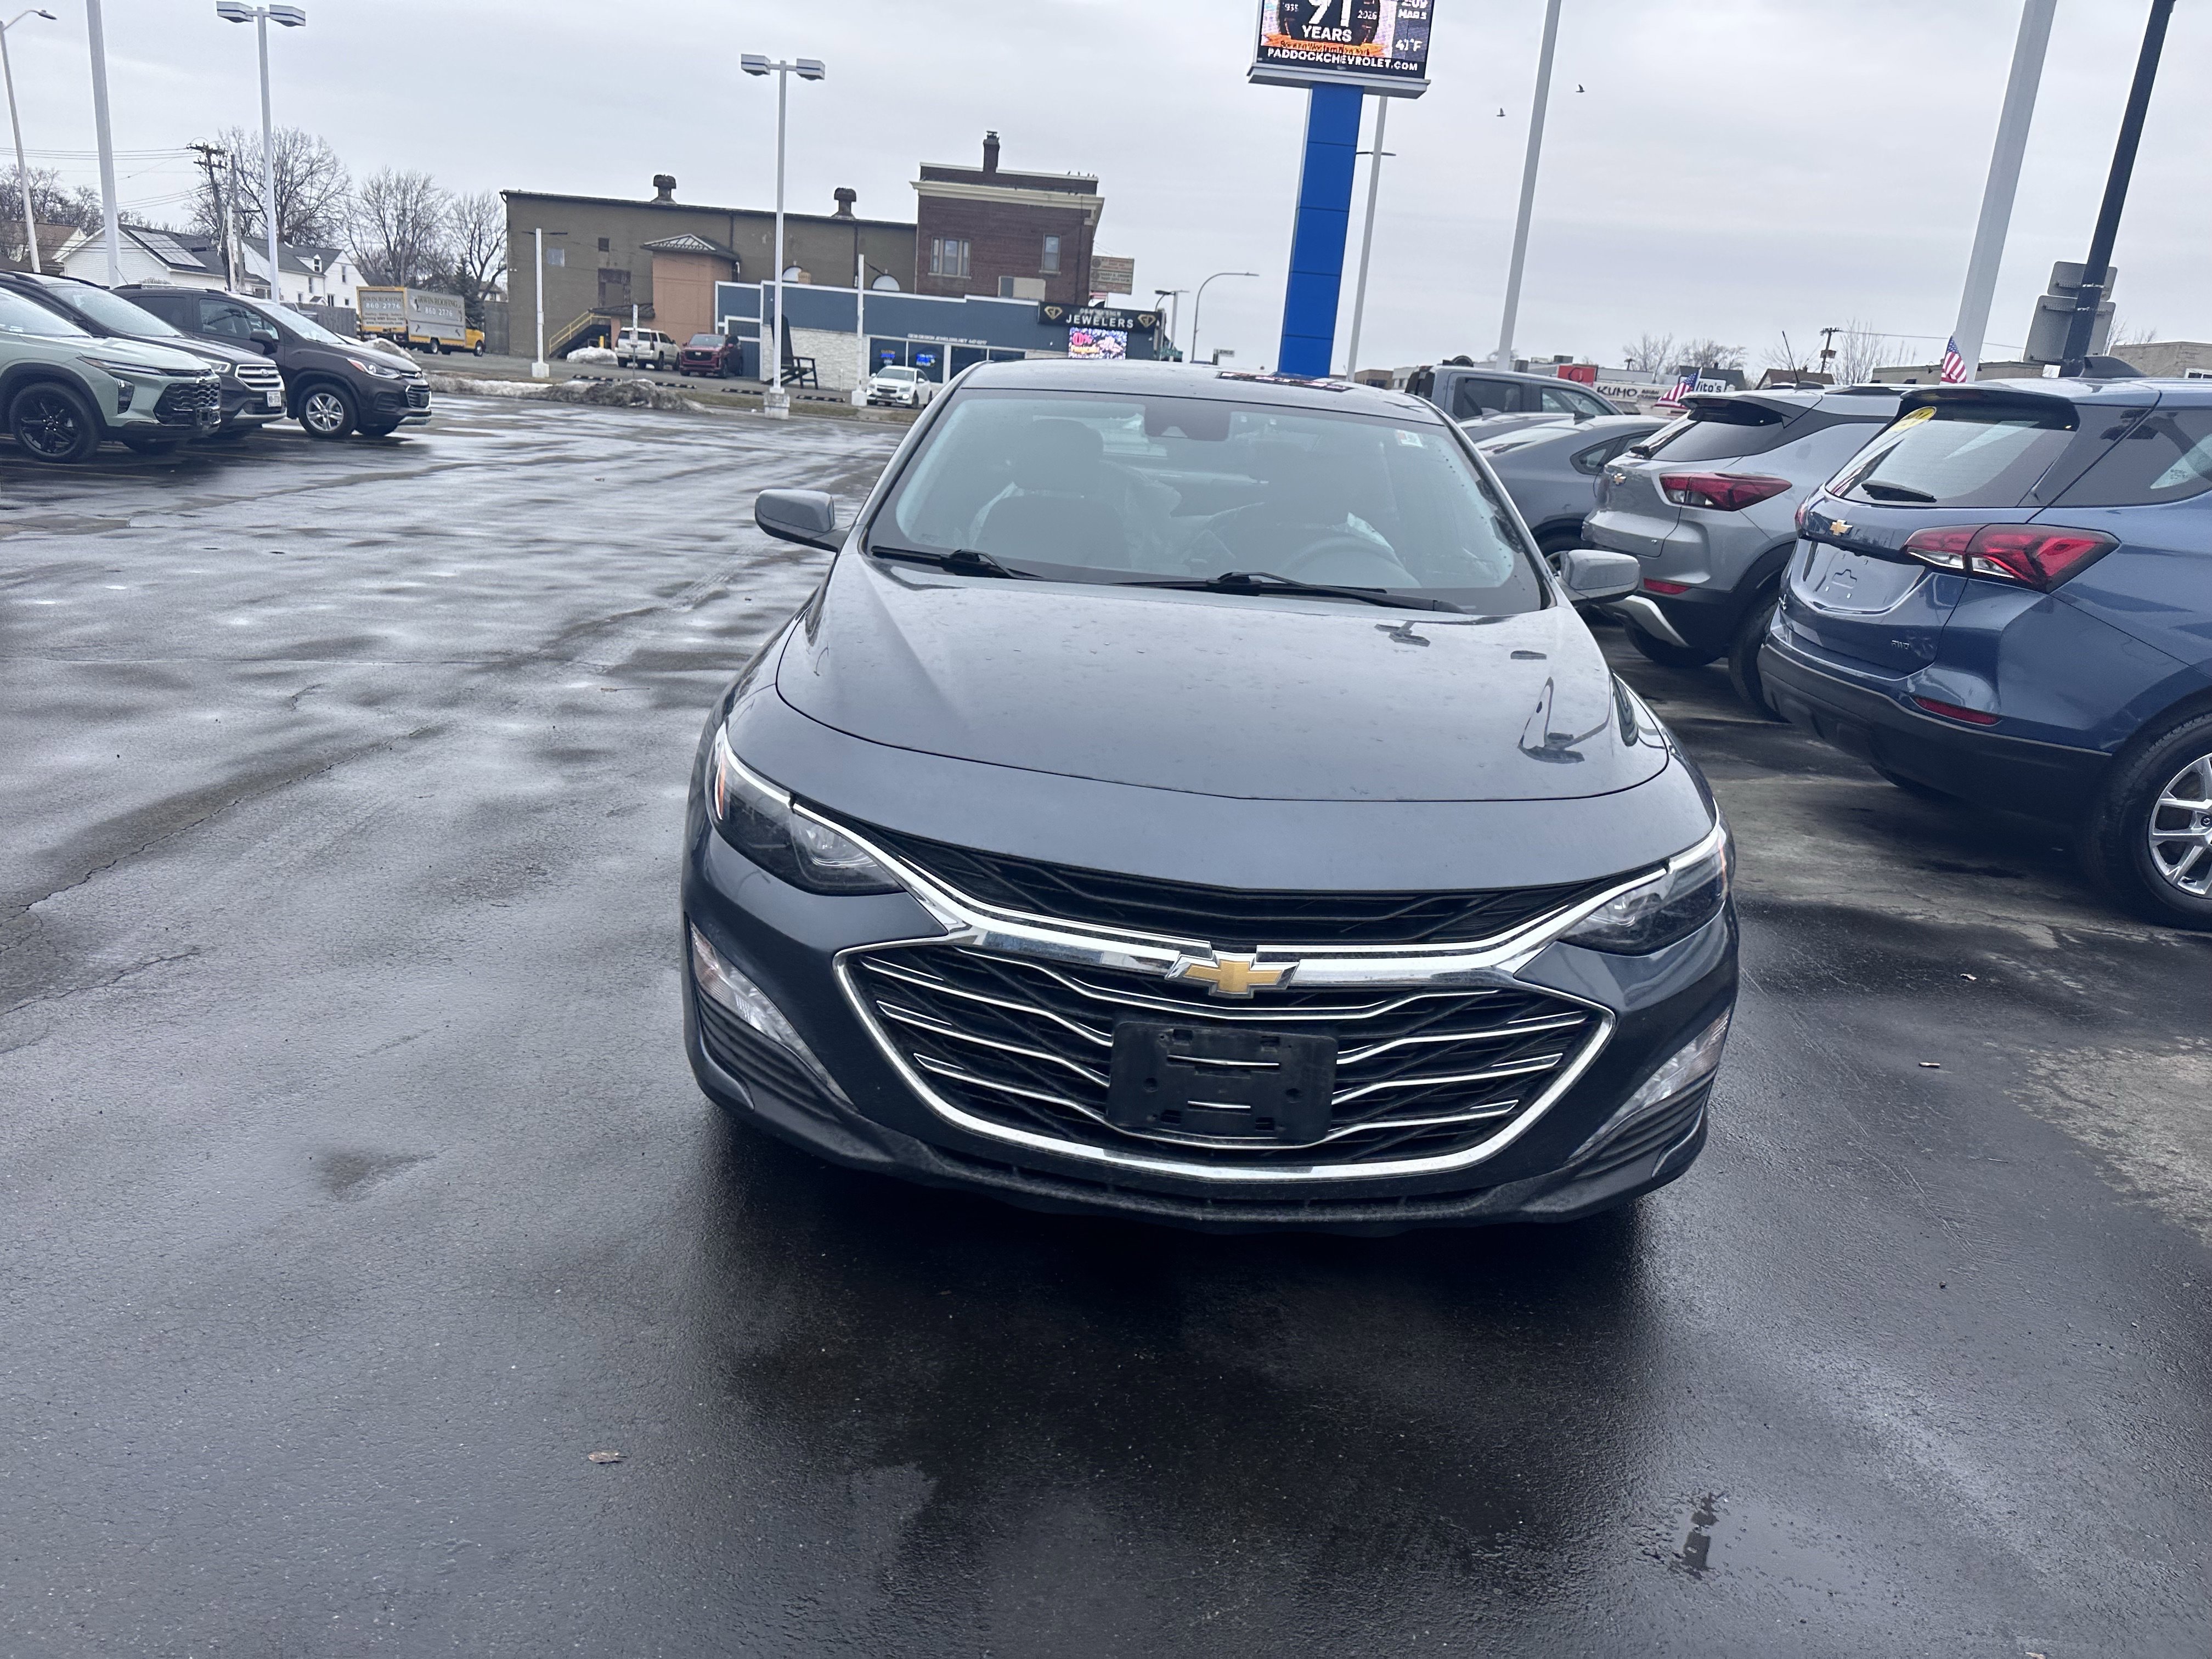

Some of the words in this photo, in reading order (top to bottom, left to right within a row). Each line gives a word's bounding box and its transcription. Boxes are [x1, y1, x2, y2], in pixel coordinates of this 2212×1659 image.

[1302, 25, 1352, 42] YEARS
[1268, 48, 1418, 71] PADDOCKCHEVROLET.COM
[425, 307, 436, 315] 860
[439, 308, 453, 317] 2776
[1066, 314, 1134, 329] JEWELERS
[1596, 386, 1638, 398] KUMO
